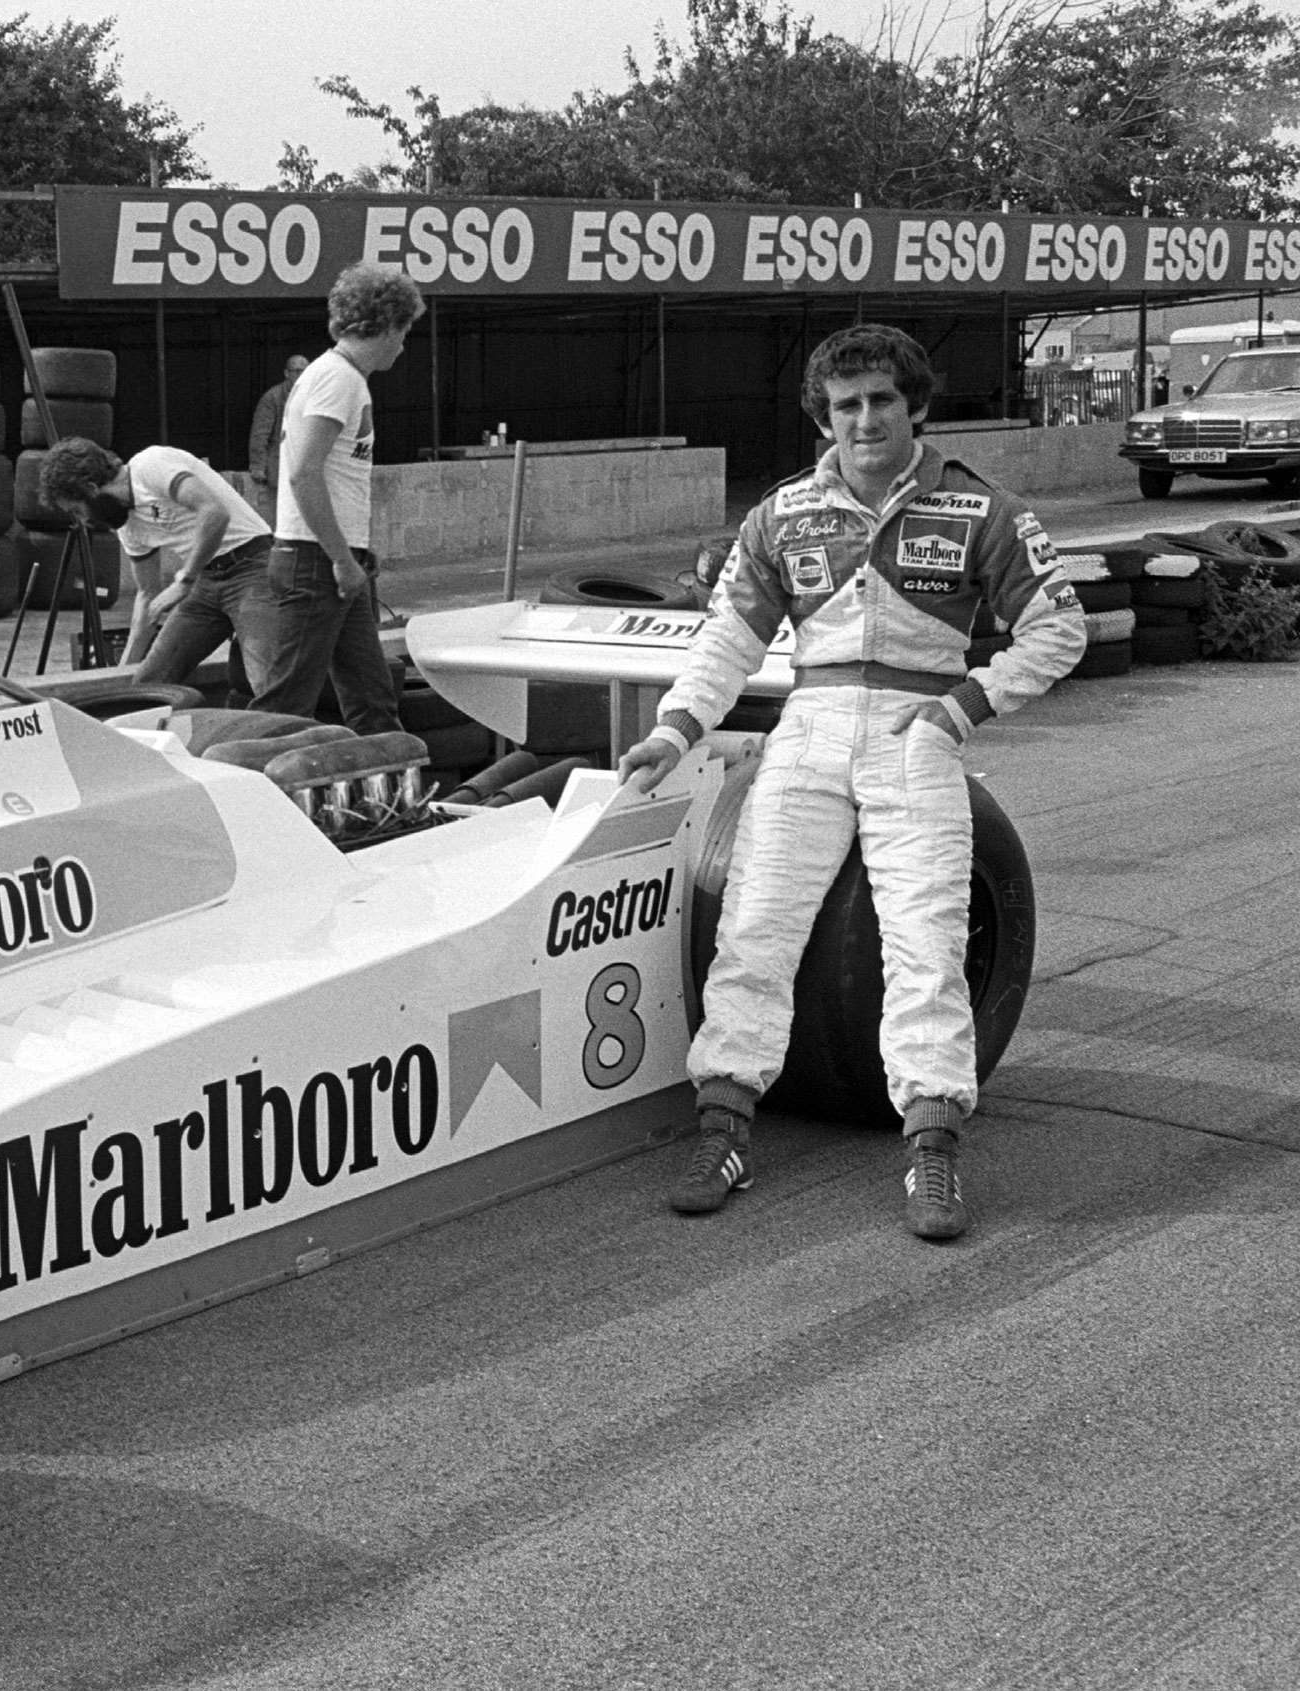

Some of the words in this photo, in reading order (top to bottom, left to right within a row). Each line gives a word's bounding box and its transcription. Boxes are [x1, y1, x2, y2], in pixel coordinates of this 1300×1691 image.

[112, 200, 322, 285] ESSO
[361, 206, 535, 283] ESSO
[567, 210, 716, 283] ESSO
[743, 215, 873, 282] ESSO
[893, 220, 1006, 282] ESSO
[1025, 223, 1127, 282] ESSO
[1144, 227, 1230, 282] ESSO
[1244, 229, 1300, 281] ESS
[794, 517, 839, 539] Prost
[948, 497, 983, 510] YEAR
[903, 540, 962, 562] Marlboro
[546, 867, 674, 957] Castrol
[582, 962, 645, 1090] 8
